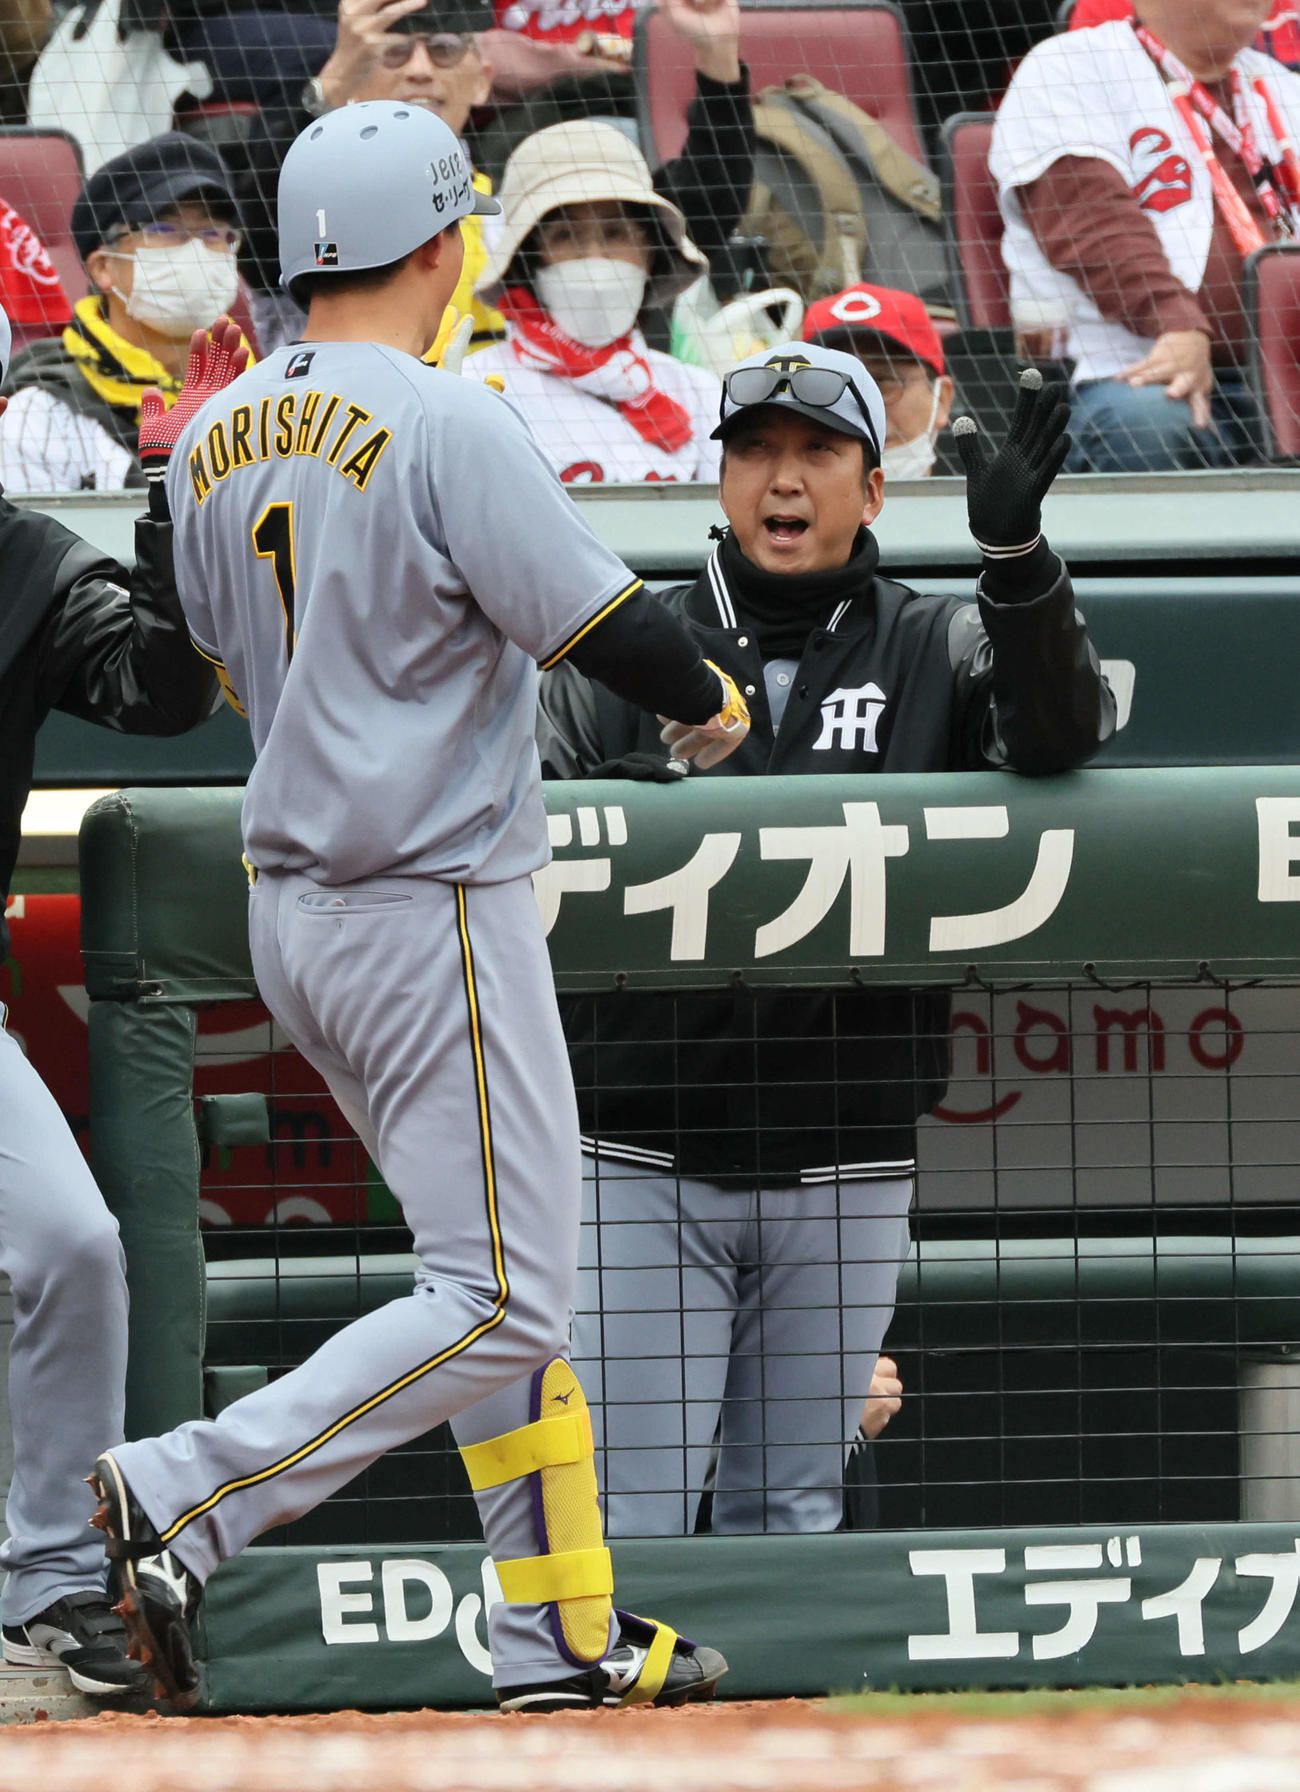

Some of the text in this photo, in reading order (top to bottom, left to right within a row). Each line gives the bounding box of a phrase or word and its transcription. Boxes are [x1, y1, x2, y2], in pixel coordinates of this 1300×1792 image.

[315, 208, 327, 239] 1
[188, 390, 393, 507] MORISHITA
[252, 500, 296, 673] 1
